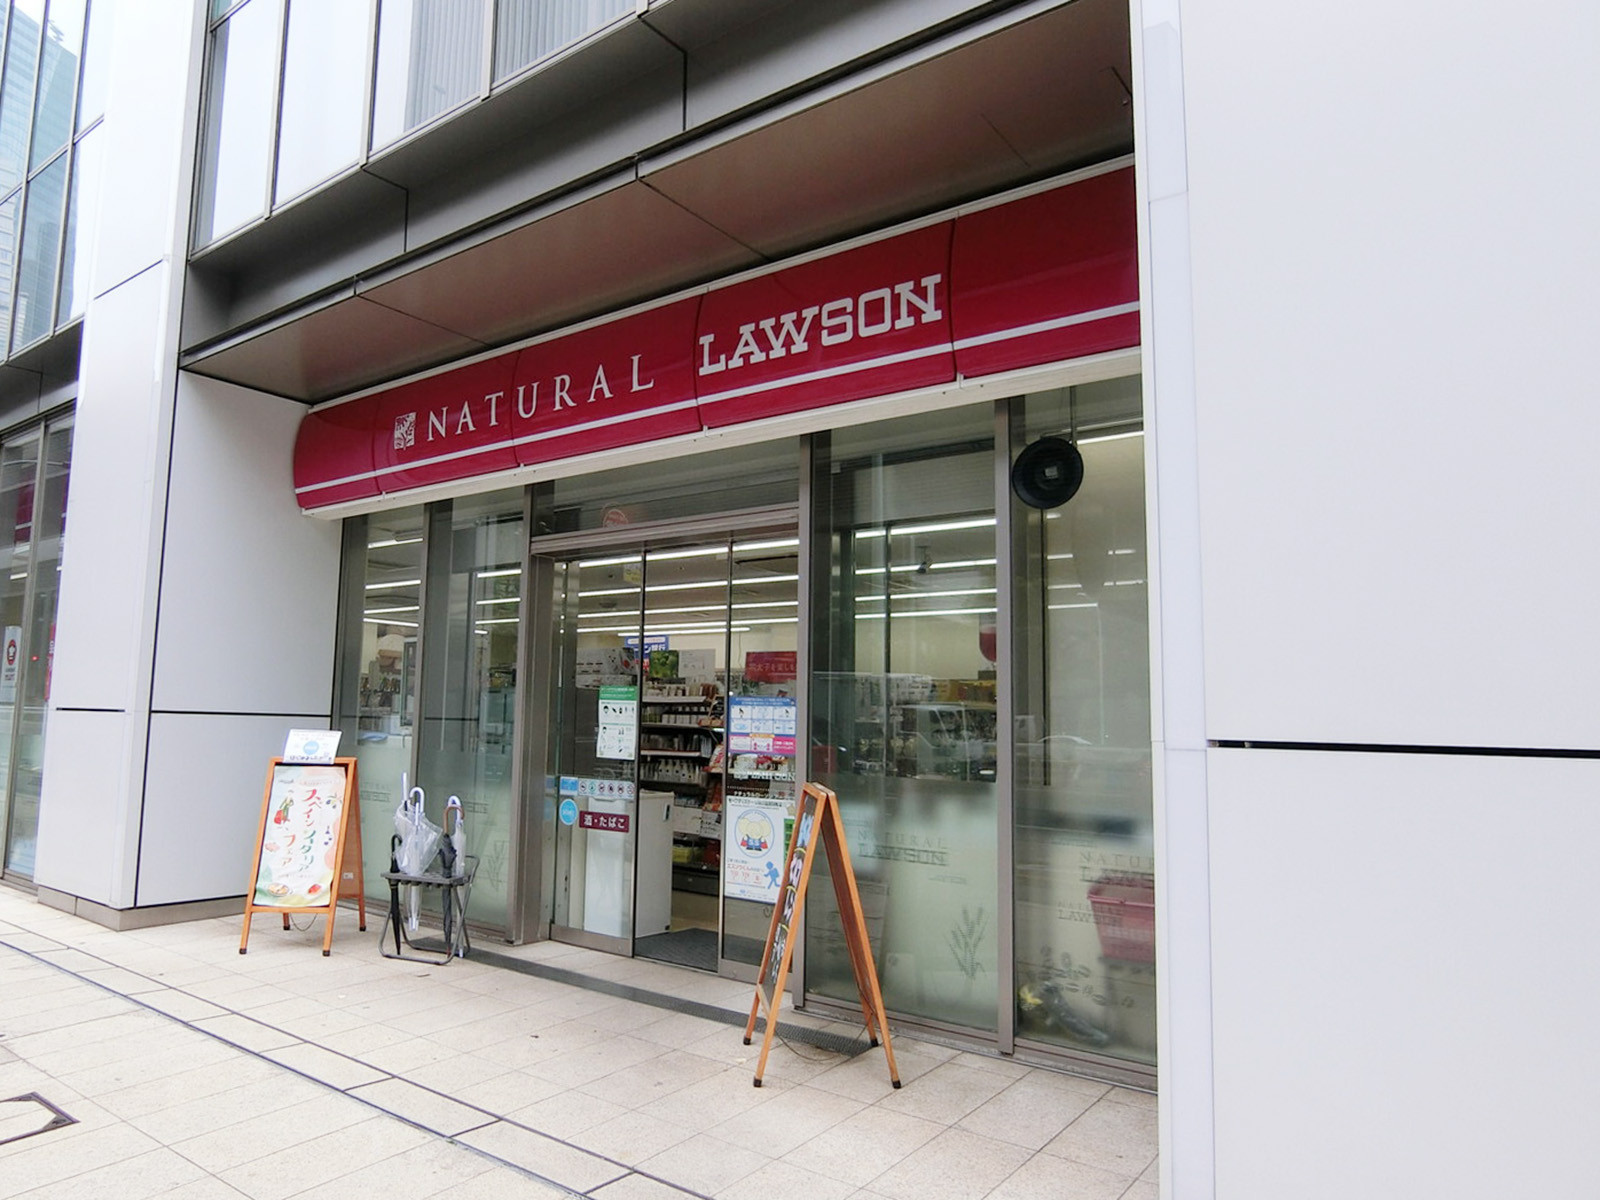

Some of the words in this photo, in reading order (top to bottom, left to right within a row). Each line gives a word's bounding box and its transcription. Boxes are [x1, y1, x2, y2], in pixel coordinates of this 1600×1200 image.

[426, 353, 655, 442] NATURAL
[698, 272, 943, 377] LAWSON
[583, 814, 626, 830] 酒・たばこ
